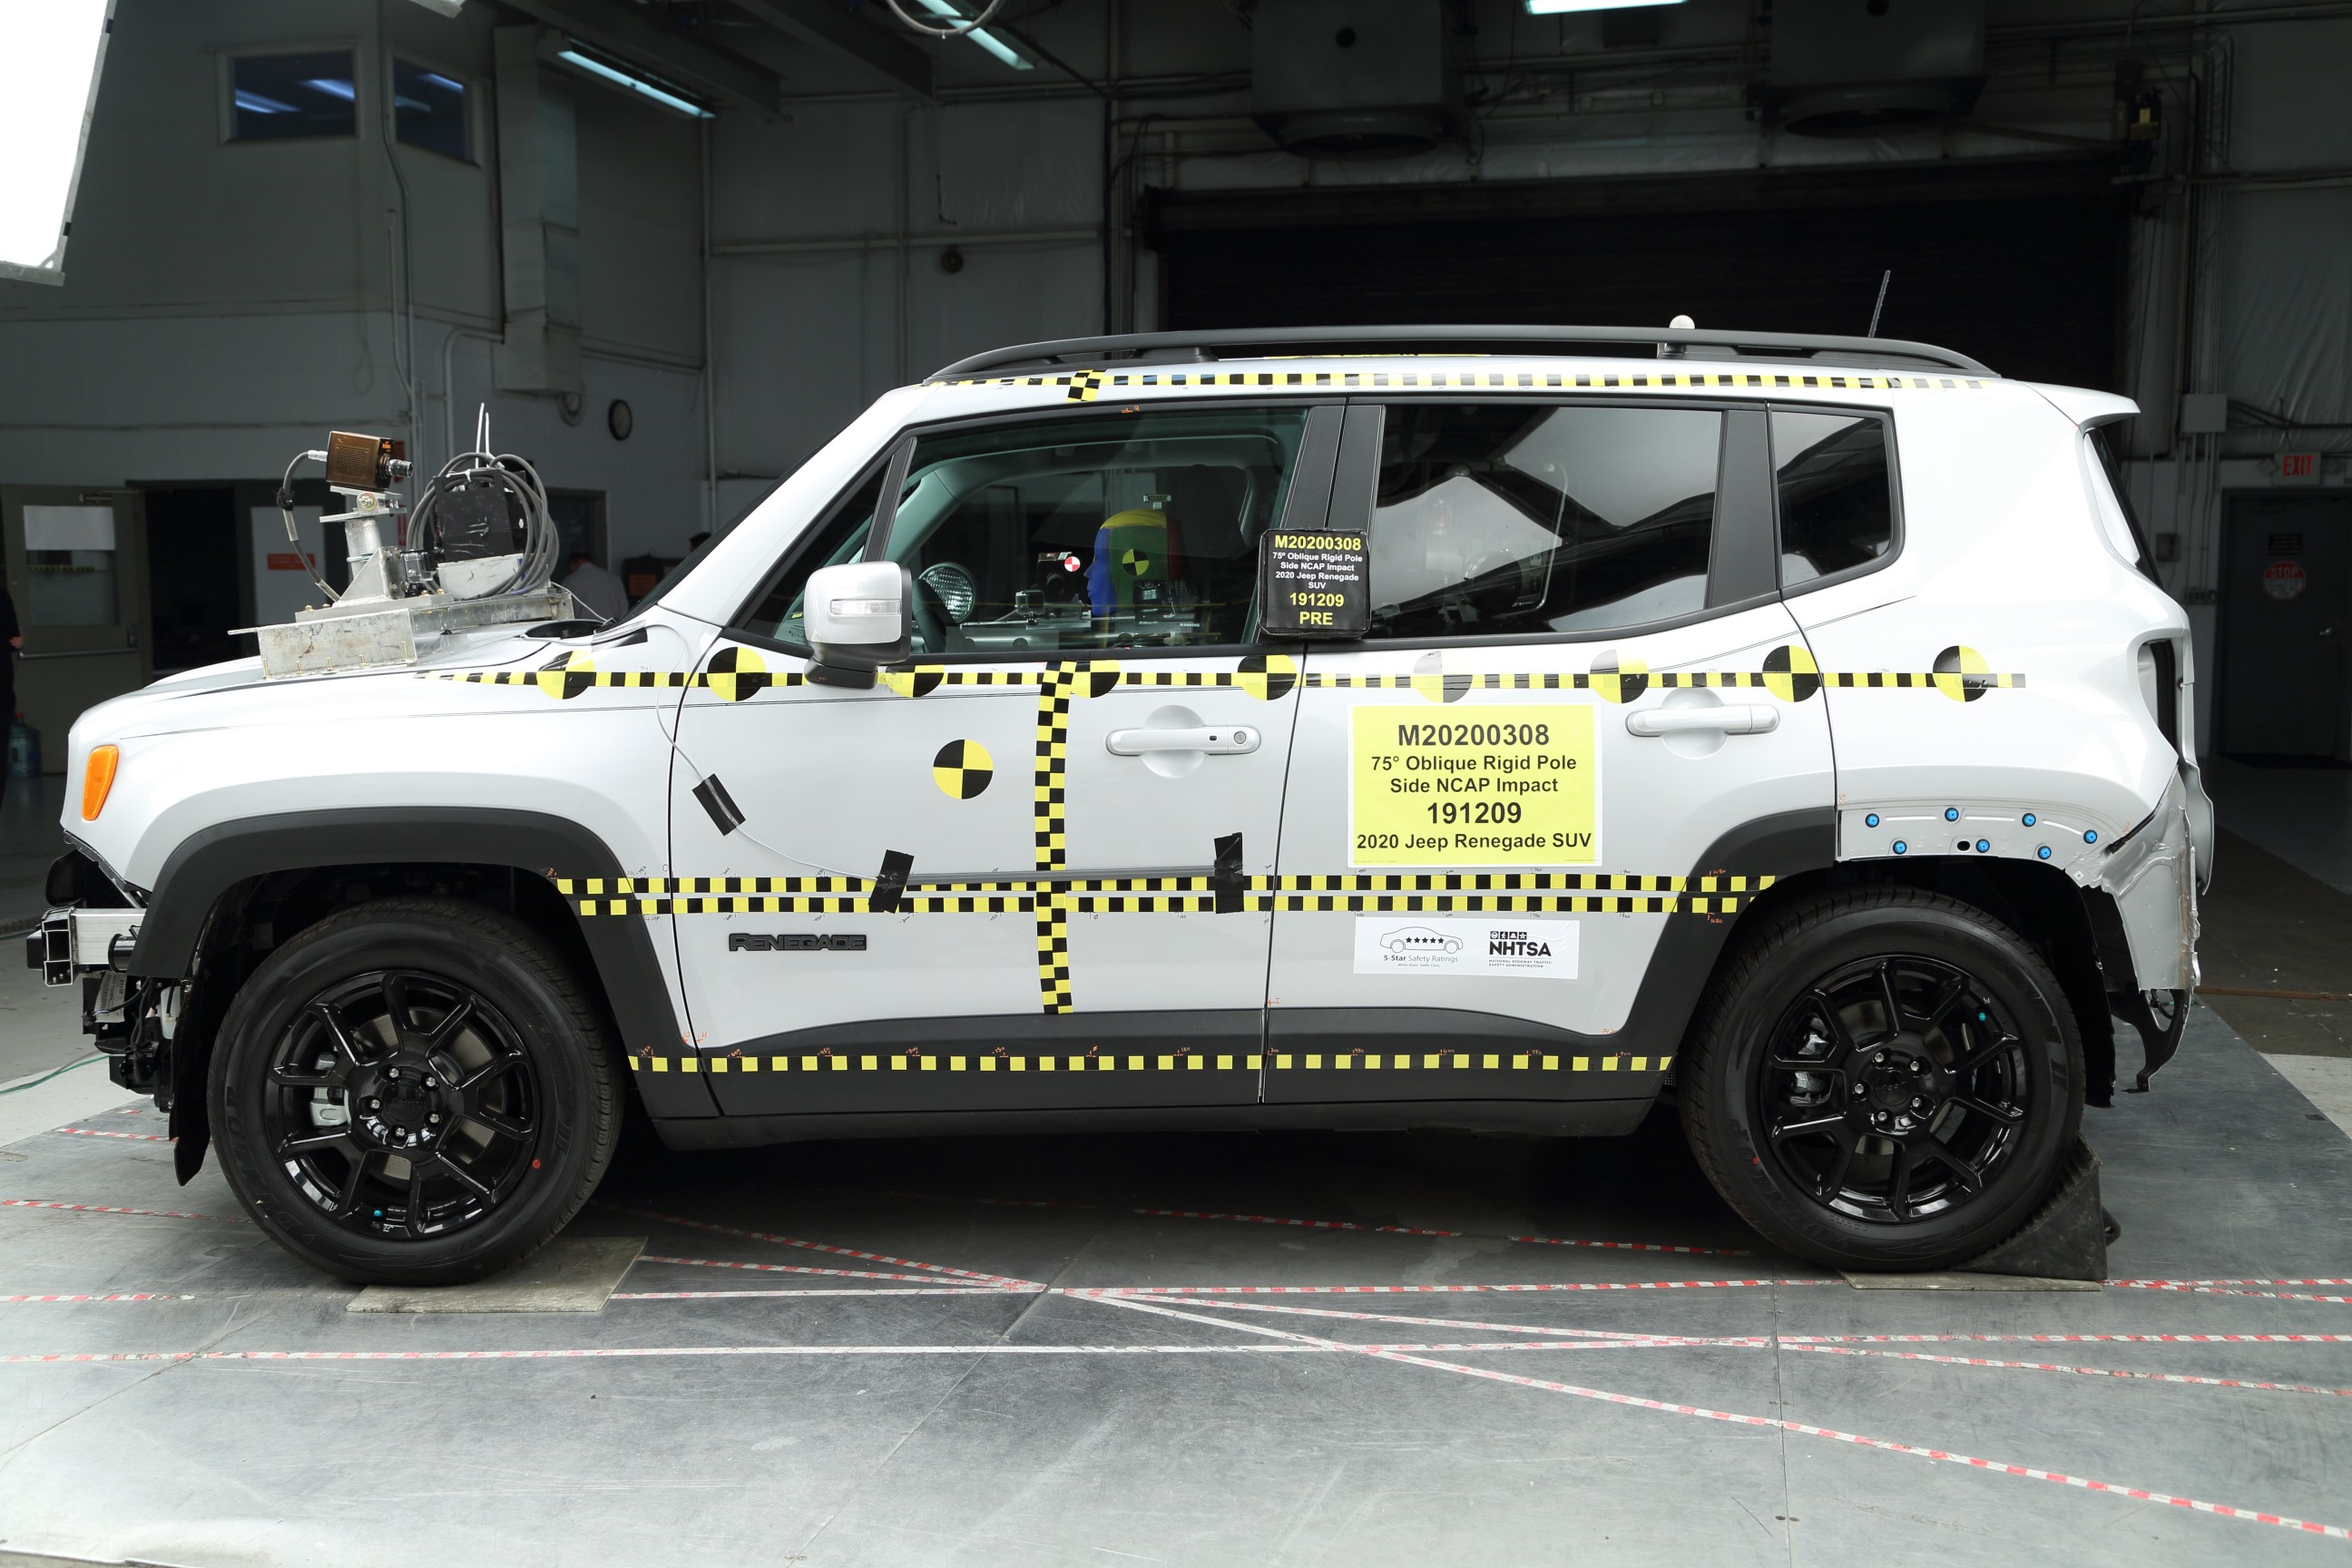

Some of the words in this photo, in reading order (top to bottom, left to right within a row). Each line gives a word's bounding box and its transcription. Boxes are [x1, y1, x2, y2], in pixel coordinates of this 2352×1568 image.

[2283, 456, 2314, 476] EXIT
[1275, 534, 1361, 551] M20200308
[1287, 553, 1319, 562] Oblique
[1321, 554, 1343, 563] Rigid
[1344, 554, 1363, 563] Pole
[1280, 561, 1298, 570] Side
[1300, 562, 1325, 571] NCAP
[1327, 564, 1355, 572] Impact
[2269, 566, 2299, 578] STOP
[1275, 571, 1295, 580] 2020
[1297, 572, 1317, 582] Jeep
[1318, 573, 1359, 583] Renegade
[1289, 593, 1345, 607] 191209
[1299, 612, 1334, 625] PRE
[1398, 723, 1550, 747] M20200308
[1406, 755, 1477, 773] Oblique
[1483, 755, 1531, 773] Rigid
[1537, 755, 1577, 770] Pole
[1390, 778, 1431, 793] Side
[1436, 778, 1490, 792] NCAP
[1496, 778, 1559, 795] Impact
[1427, 802, 1522, 825] 191209
[1357, 834, 1399, 848] 2020
[1405, 833, 1448, 851] Jeep
[1455, 833, 1546, 852] Renegade
[1552, 832, 1592, 848] SUV
[729, 933, 867, 951] RENEGADE
[1489, 941, 1552, 956] NHTSA
[1408, 955, 1430, 963] Safety
[1432, 956, 1458, 964] Ratings
